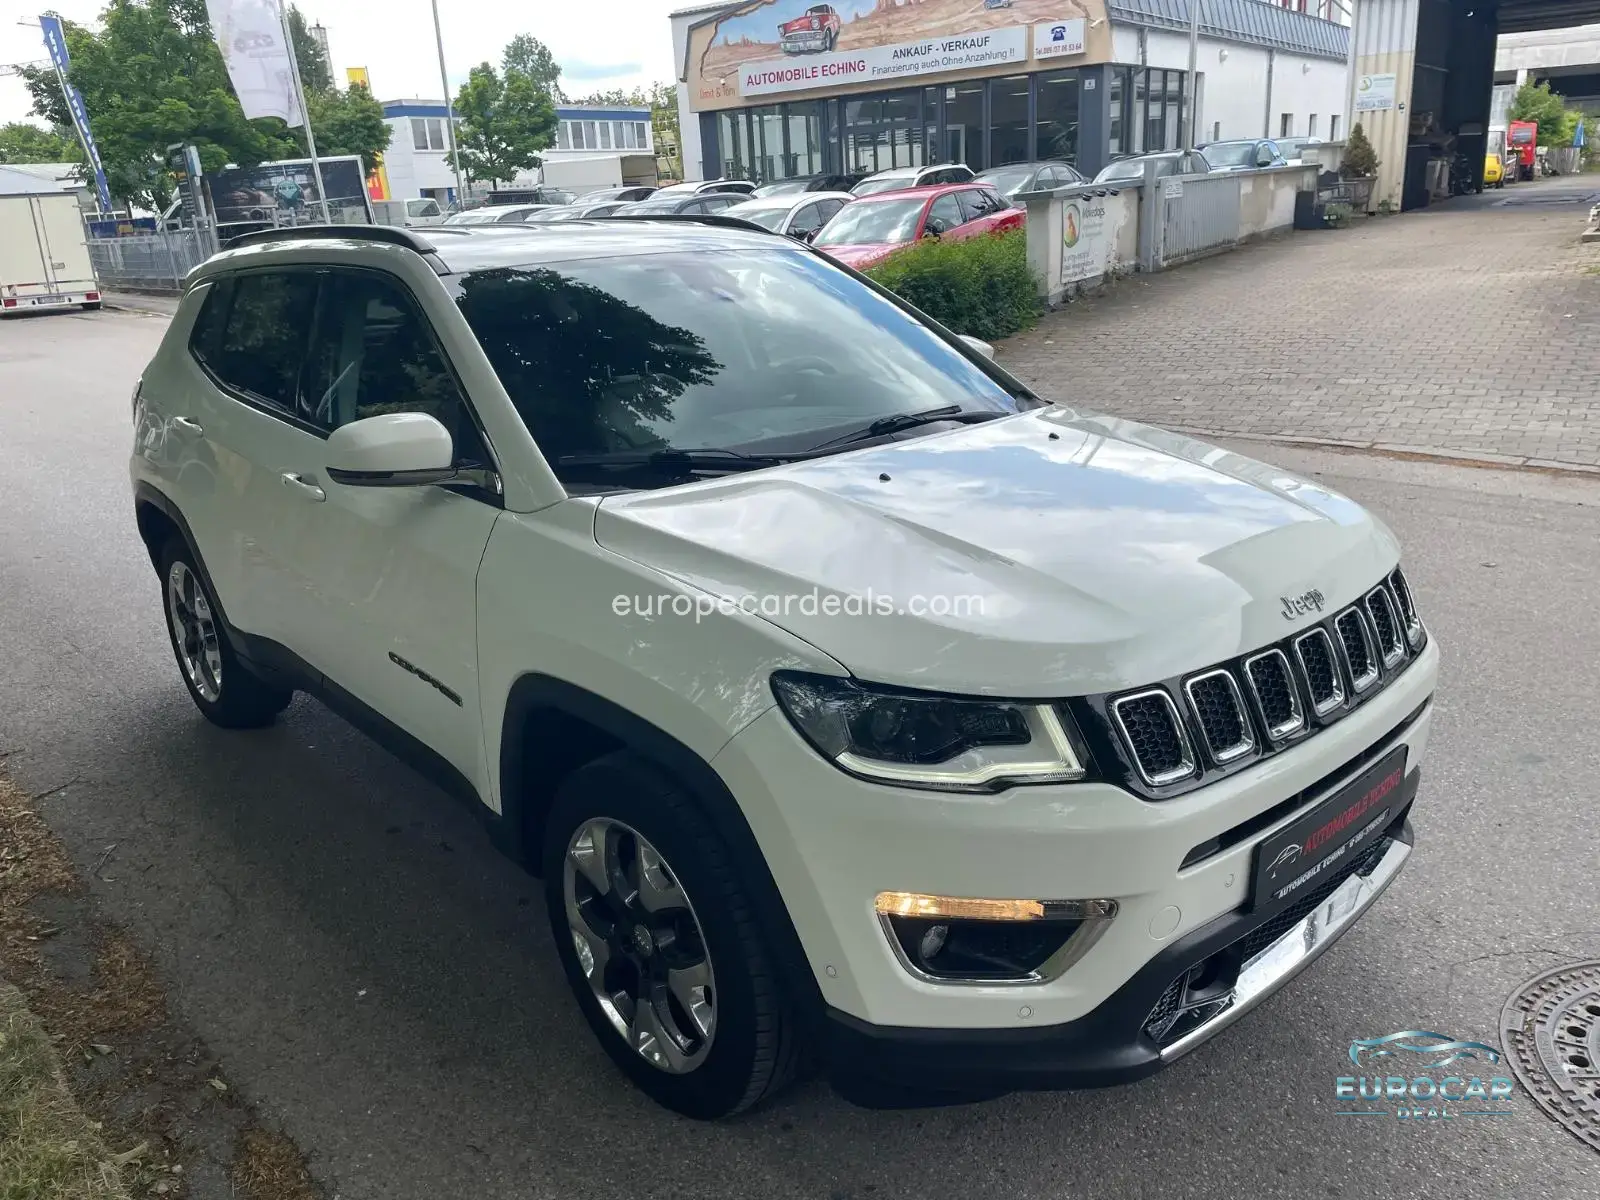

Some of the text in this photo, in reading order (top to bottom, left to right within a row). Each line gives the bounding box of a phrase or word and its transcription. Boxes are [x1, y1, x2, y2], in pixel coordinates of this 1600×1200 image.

[871, 62, 920, 76] Finanzierung
[921, 58, 940, 69] auch
[941, 55, 964, 66] Ohne
[964, 49, 1008, 64] Anzahlung
[892, 44, 933, 60] ANKAUF
[941, 36, 991, 53] VERKAUF
[746, 60, 866, 87] AUTOMOBILE ECHING
[1280, 589, 1325, 620] Jeep
[1302, 794, 1369, 856] AUTOMOBILE
[1369, 767, 1401, 807] ECHING
[1278, 864, 1321, 899] AUTOMOBILE
